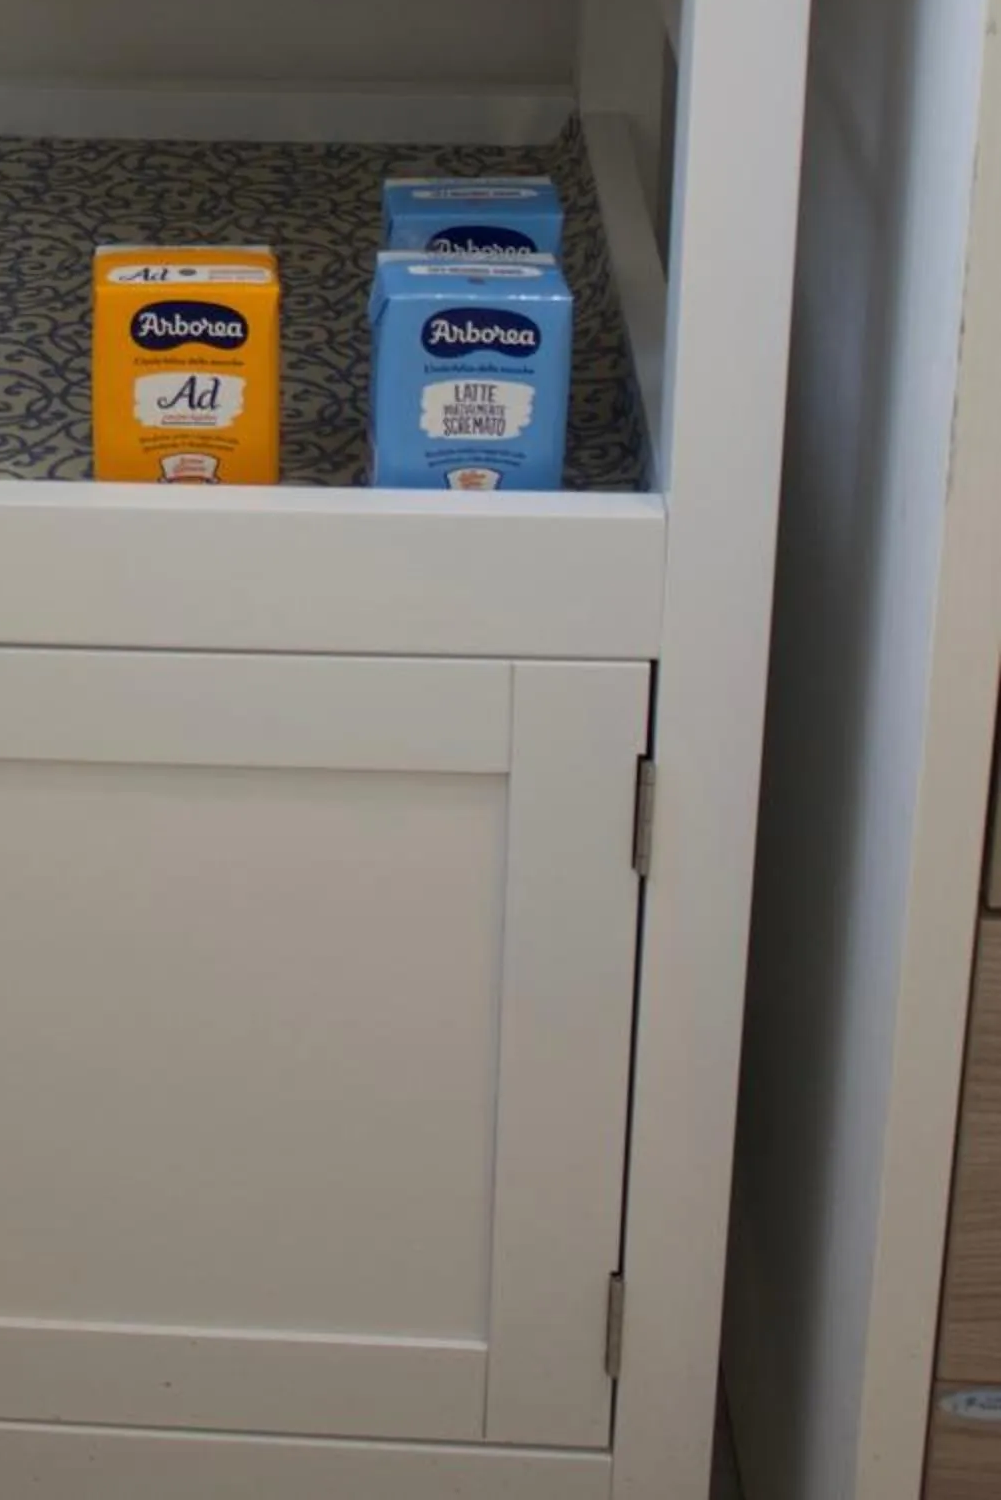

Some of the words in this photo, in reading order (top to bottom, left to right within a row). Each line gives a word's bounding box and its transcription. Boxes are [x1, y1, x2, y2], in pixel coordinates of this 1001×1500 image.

[138, 311, 244, 337] Arborea
[429, 319, 535, 345] Arborea
[156, 374, 221, 410] Ad
[453, 383, 499, 402] LATTE
[442, 417, 507, 436] SCREMATO
